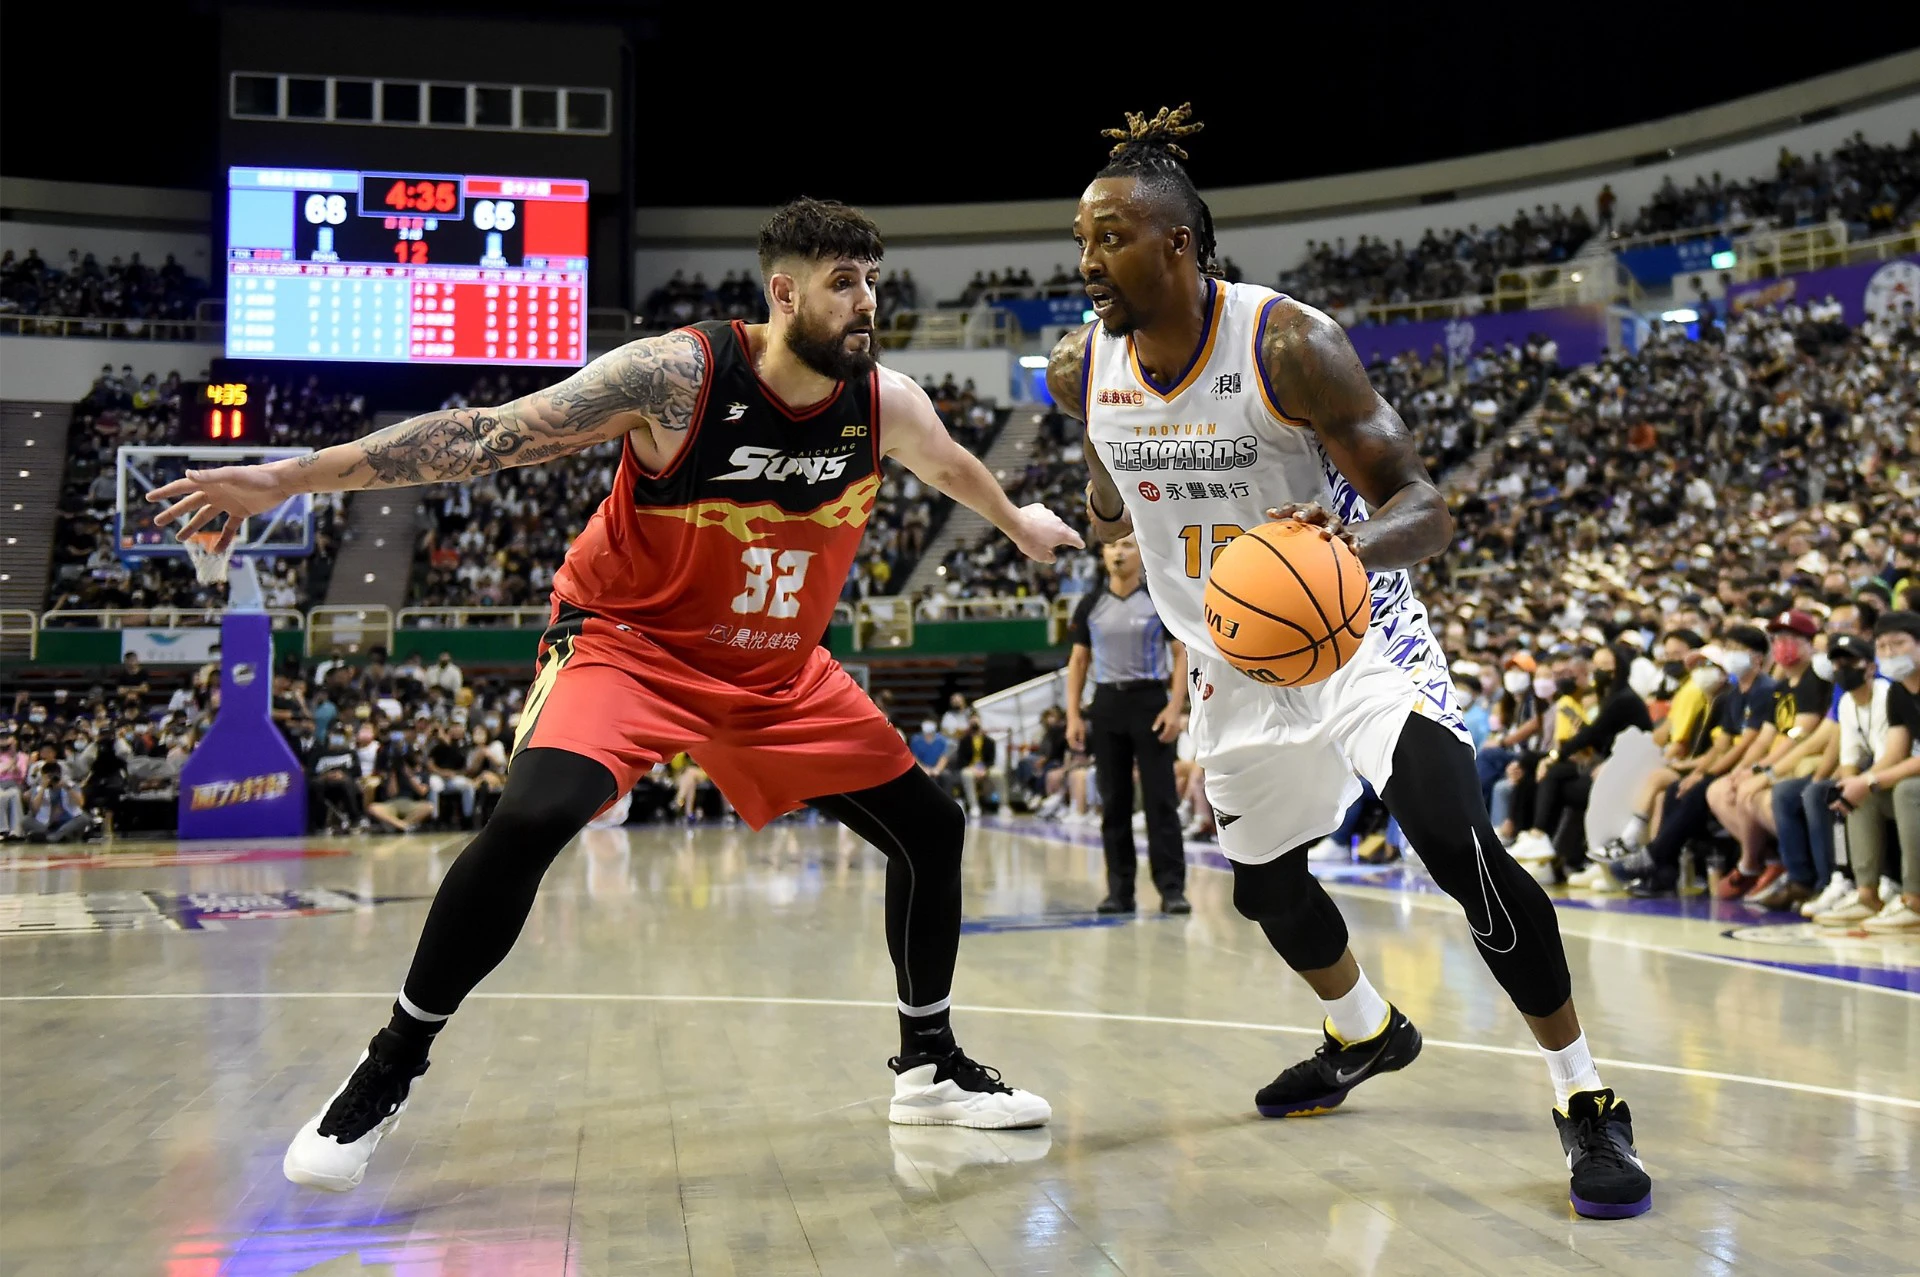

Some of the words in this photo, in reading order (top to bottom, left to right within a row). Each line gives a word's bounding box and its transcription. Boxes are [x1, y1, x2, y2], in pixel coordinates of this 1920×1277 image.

[304, 194, 347, 225] 68
[385, 180, 457, 212] 4:35
[473, 200, 516, 231] 65
[394, 240, 428, 264] 12
[212, 409, 242, 438] 11
[840, 425, 868, 437] BC
[1133, 423, 1216, 436] TAOYUAN
[791, 442, 856, 457] AICHUNG
[1106, 435, 1258, 472] LEOPARDS
[1165, 481, 1250, 501] 永豐銀行
[730, 546, 818, 619] 32
